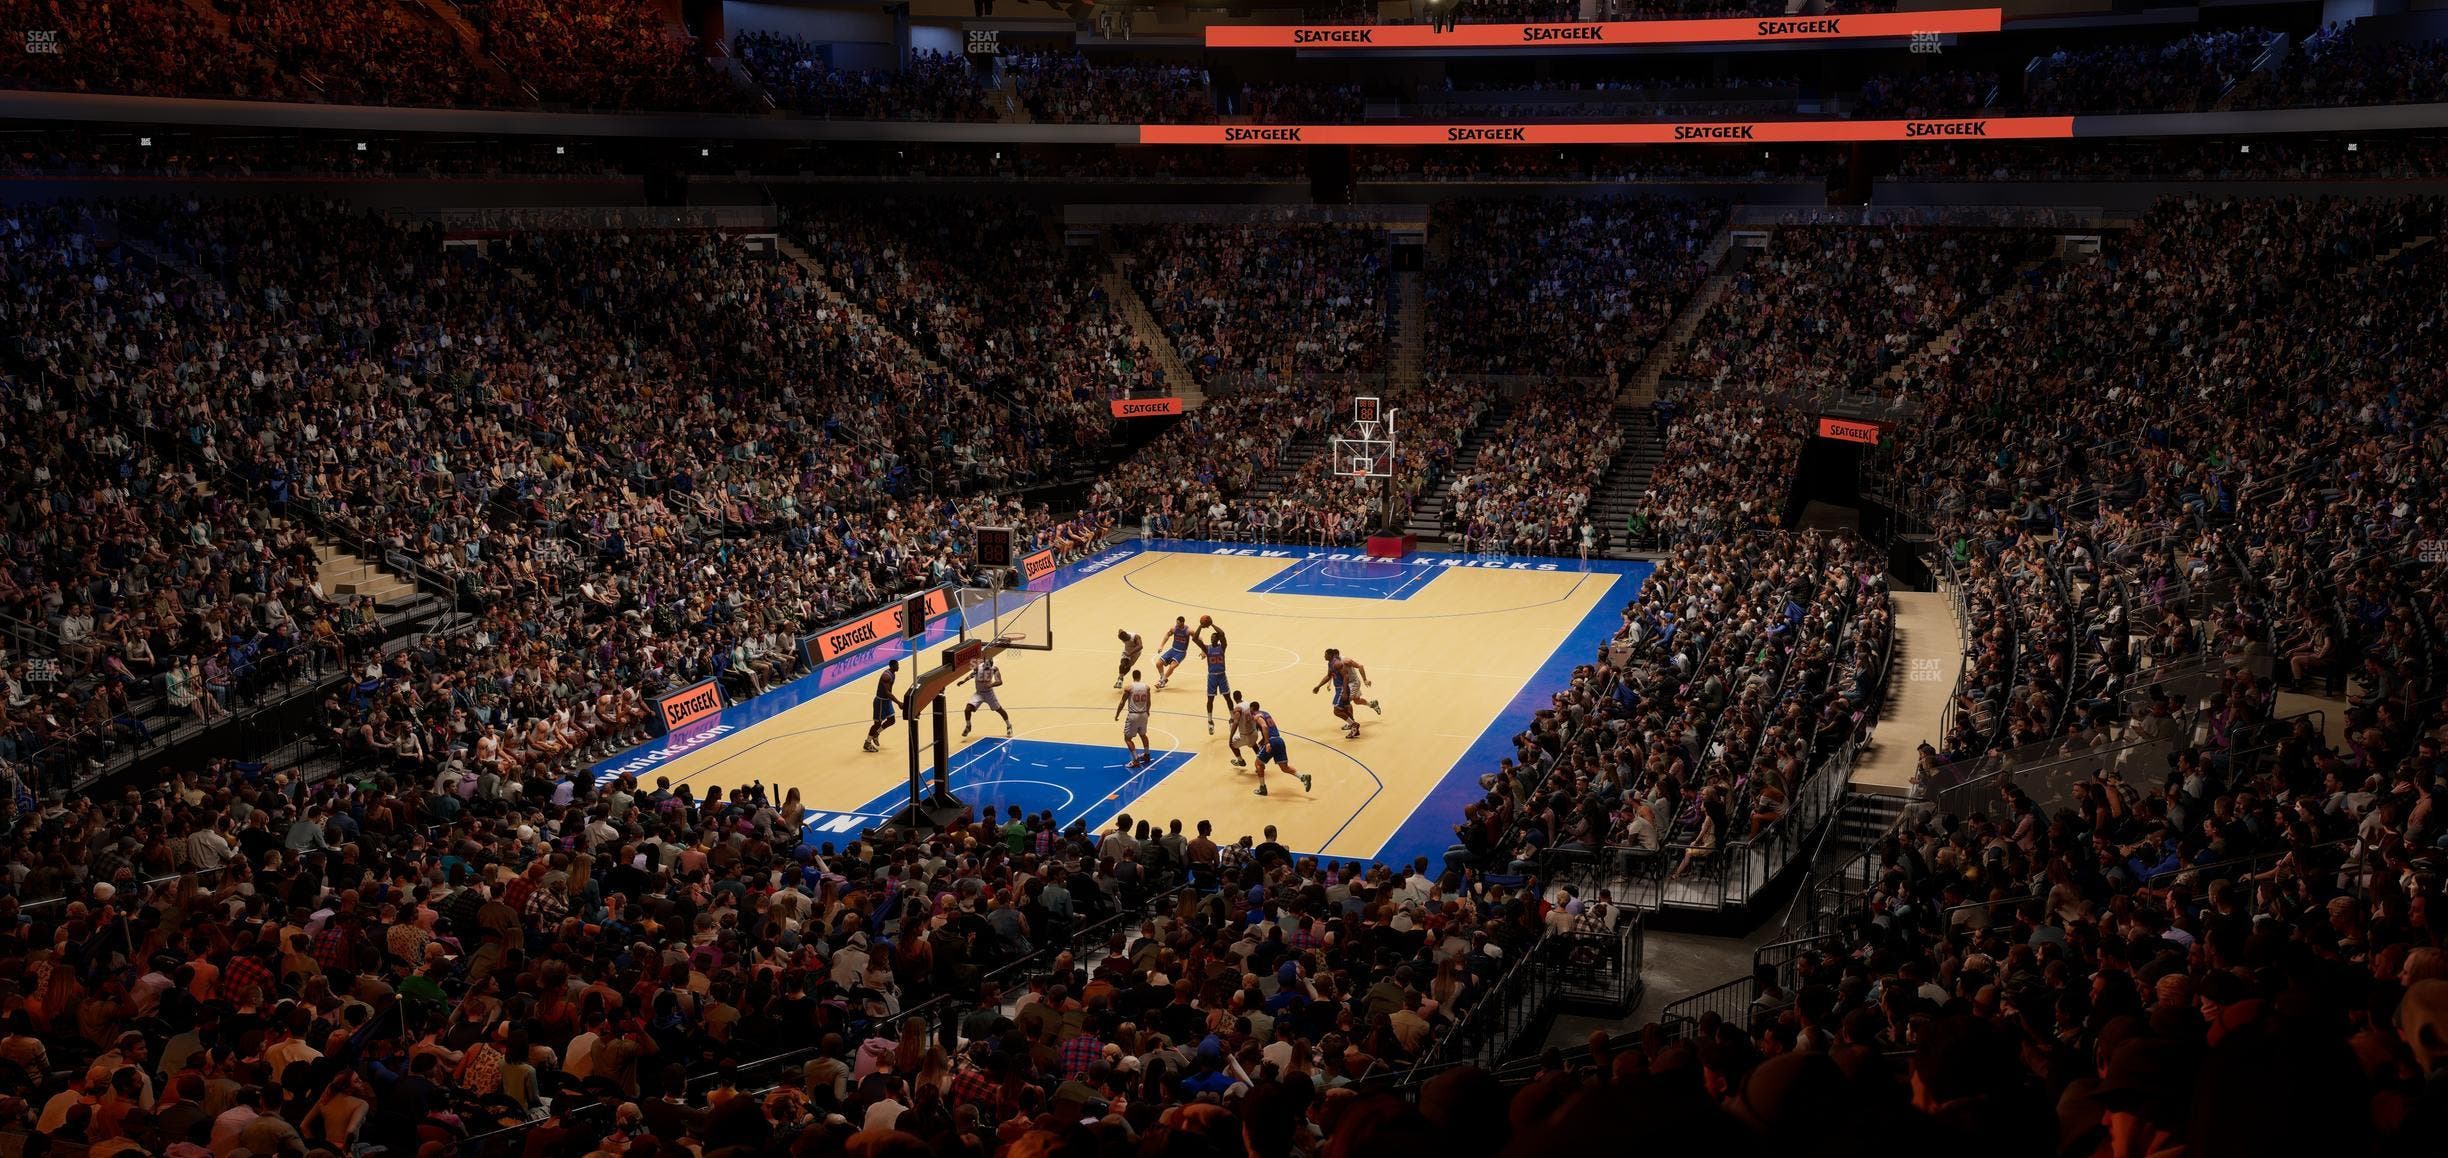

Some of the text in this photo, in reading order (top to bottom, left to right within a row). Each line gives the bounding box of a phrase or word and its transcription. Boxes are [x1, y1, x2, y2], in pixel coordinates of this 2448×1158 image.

[1524, 26, 1603, 42] SEATGEEK
[1758, 18, 1840, 36] SEATGEEK
[1294, 29, 1372, 44] SEATGEEK
[1225, 127, 1301, 142] SEATGEEK
[1448, 127, 1525, 142] SEATGEEK
[1675, 125, 1753, 140] SEATGEEK
[1906, 121, 1986, 137] SEATGEEK
[1123, 402, 1170, 414] SEATGEEK
[1830, 424, 1870, 441] SEATGEEK
[1026, 554, 1053, 577] SEATGEEK
[1212, 548, 1559, 571] NEW YORK KNICKS
[830, 621, 877, 655] SEATGEEK
[667, 688, 718, 725] SEATGEEK
